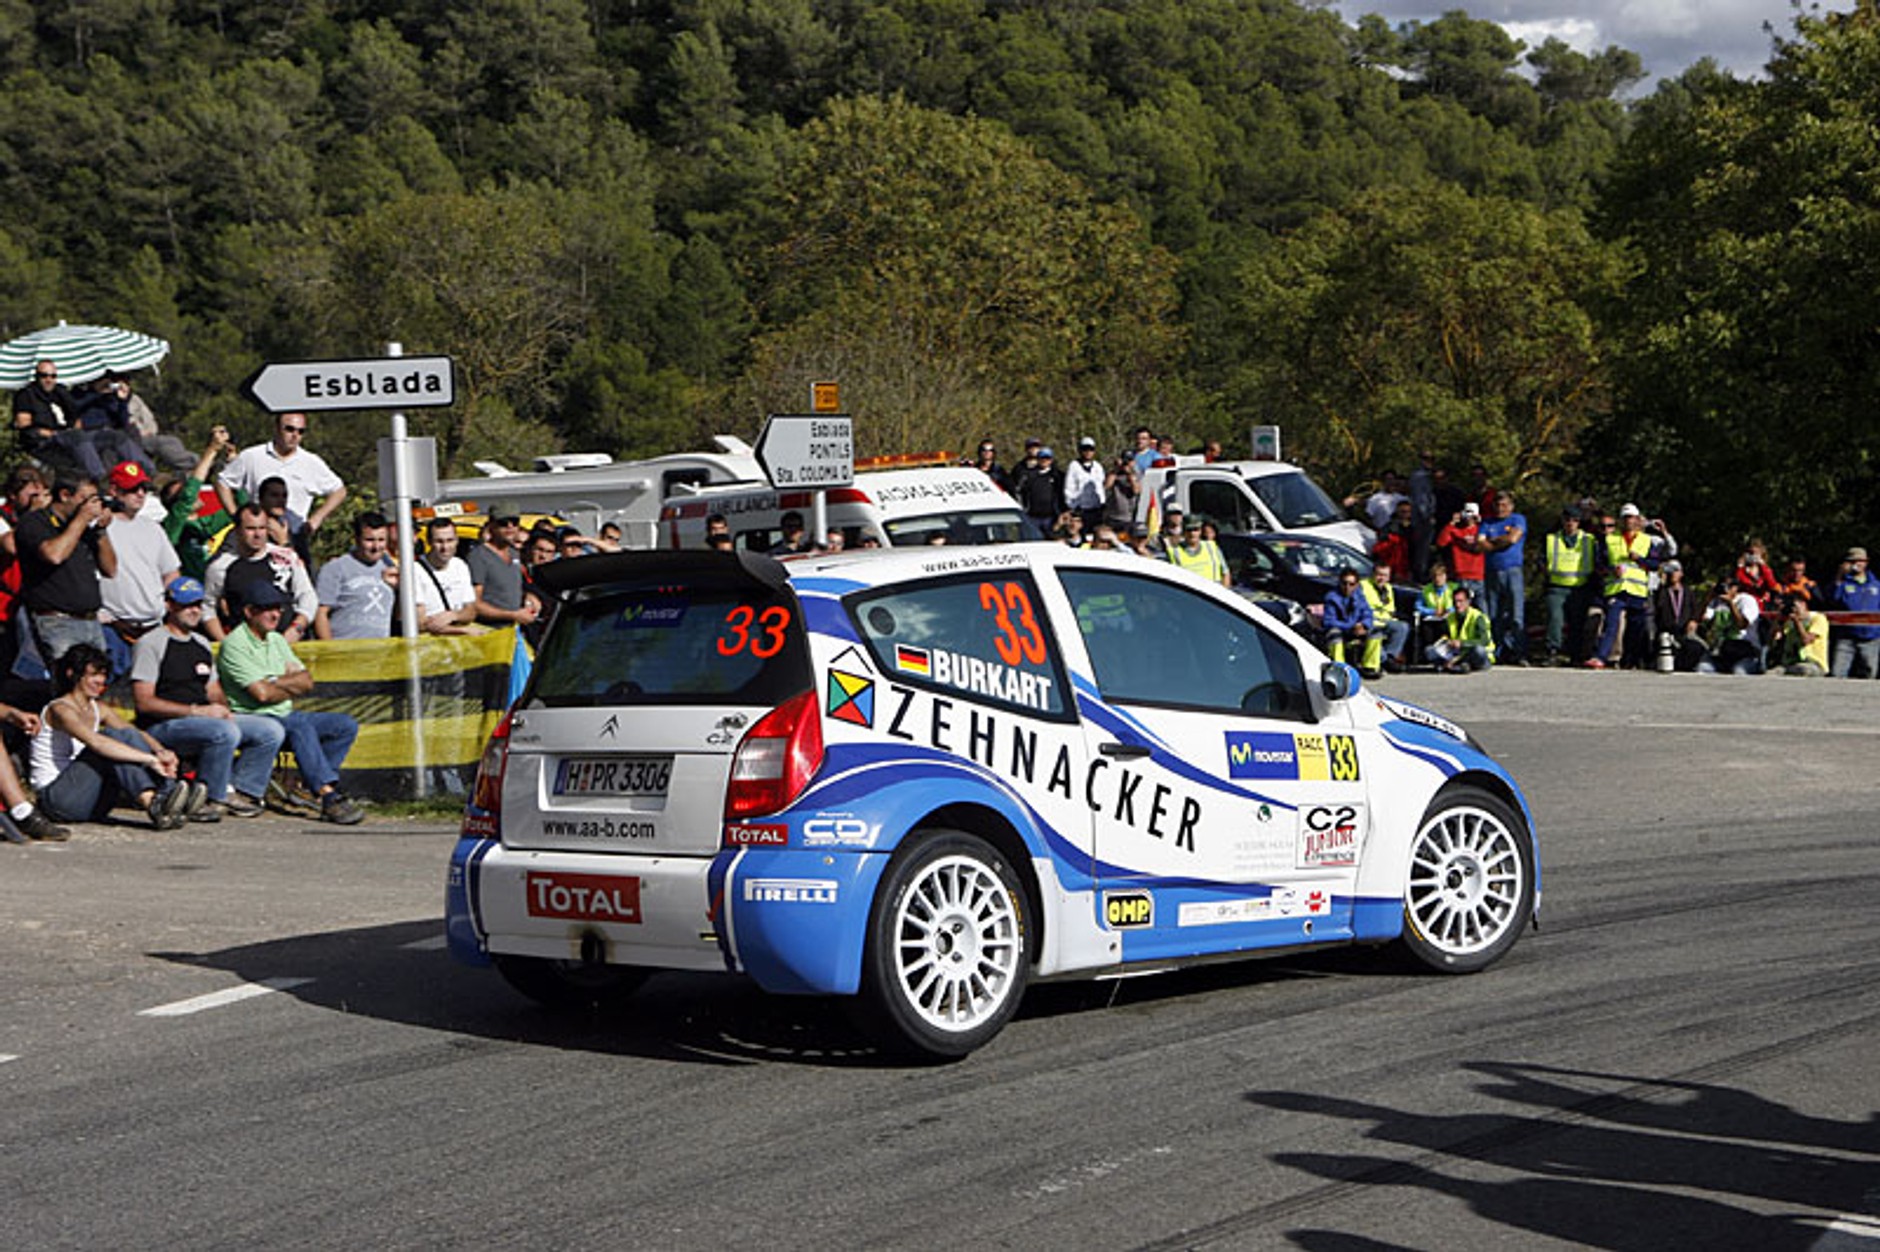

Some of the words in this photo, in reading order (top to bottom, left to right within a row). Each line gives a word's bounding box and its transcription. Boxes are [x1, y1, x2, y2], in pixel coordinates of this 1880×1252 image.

[305, 371, 441, 398] Esblada
[811, 421, 849, 438] Esblada
[810, 443, 850, 459] PONTILS
[799, 465, 838, 481] COLOMA
[708, 494, 778, 517] AMBULANCIA
[716, 605, 791, 659] 33
[979, 582, 1047, 667] 33
[932, 648, 1051, 711] BURKART
[887, 685, 1201, 853] ZEHNACKER
[1329, 735, 1358, 780] 33
[565, 764, 582, 790] H
[590, 763, 617, 791] PR
[619, 762, 669, 791] 3306
[543, 818, 655, 838] www.aa-b.com
[1306, 806, 1357, 831] C2
[729, 826, 785, 843] TOTAL
[531, 878, 634, 915] TOTAL
[744, 878, 838, 903] PIRELLI
[1109, 899, 1151, 923] OMP
